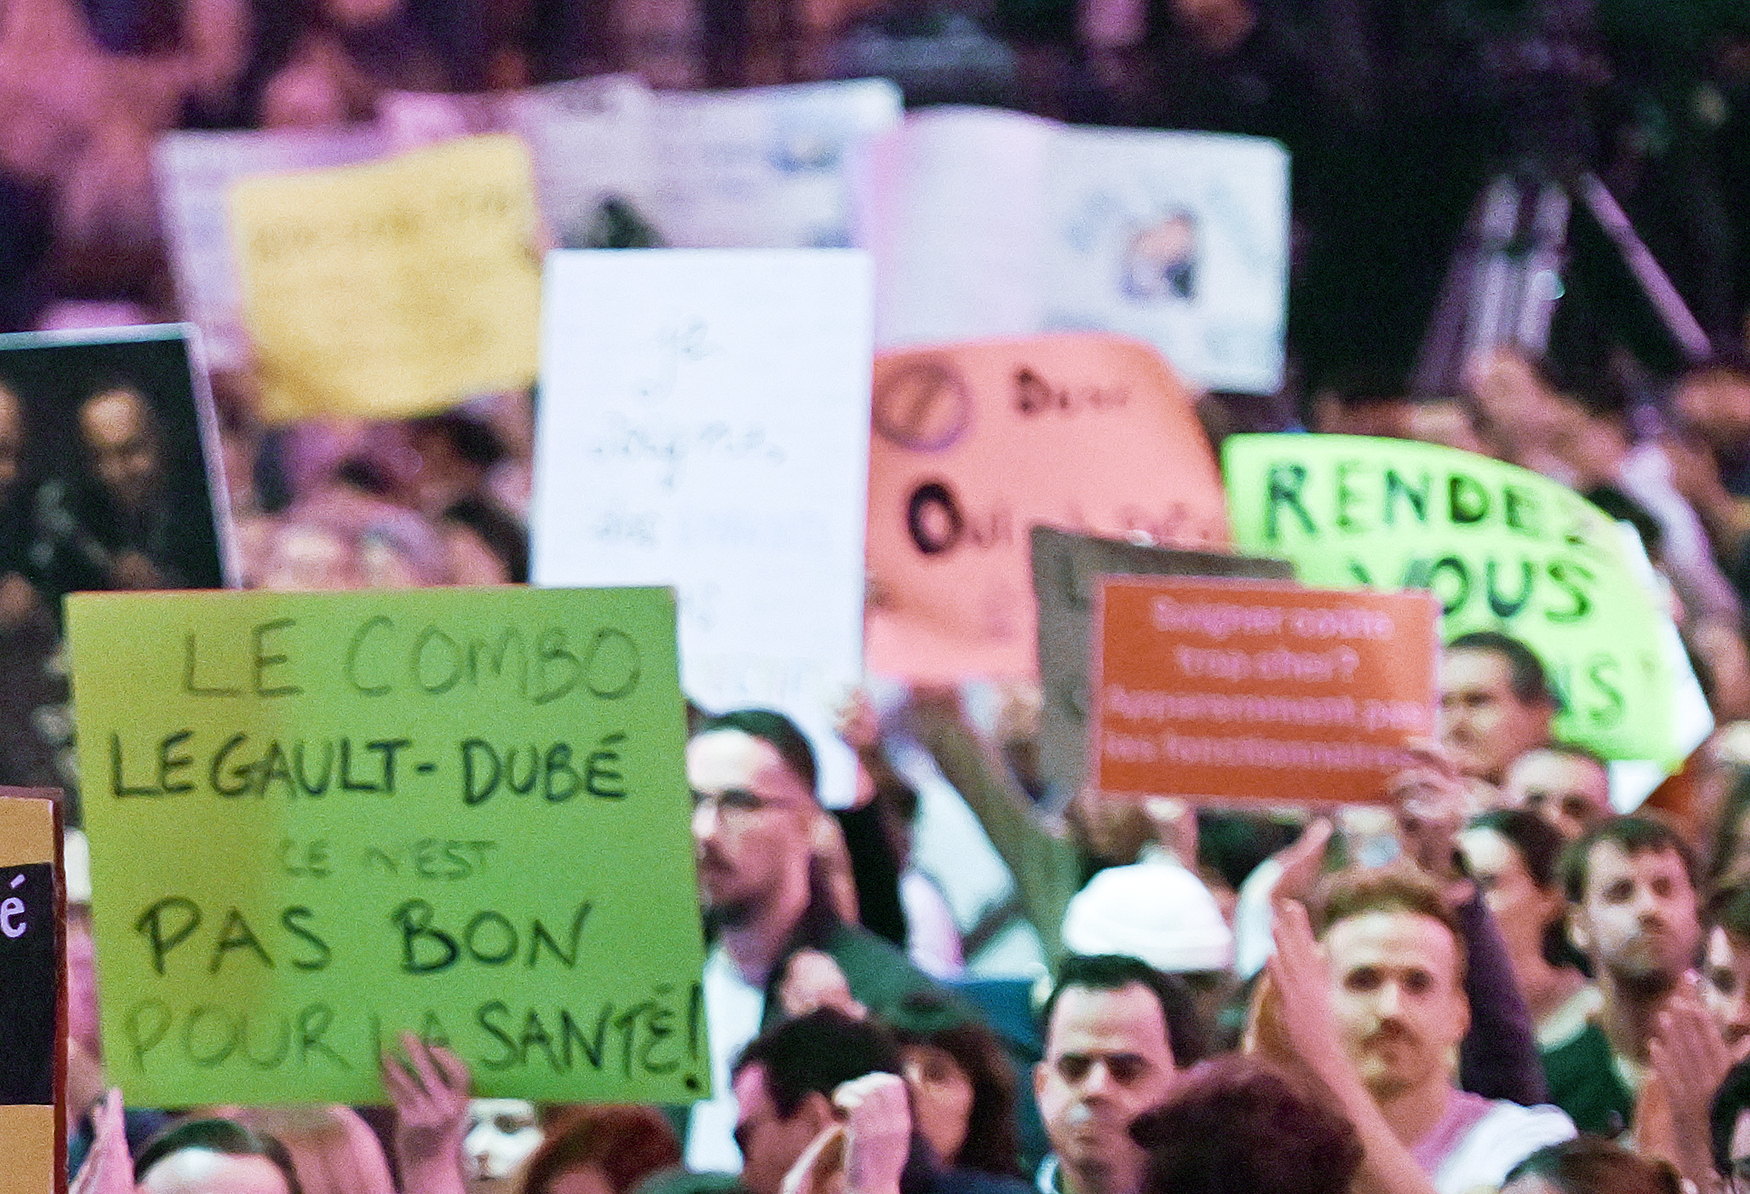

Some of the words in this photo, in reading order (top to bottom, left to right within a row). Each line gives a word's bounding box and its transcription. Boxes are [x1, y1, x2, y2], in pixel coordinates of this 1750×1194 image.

[184, 617, 305, 699] LE
[343, 614, 643, 705] COMBO
[109, 729, 628, 804] LEGAULT-DUBÉ
[133, 895, 333, 976] PAS
[392, 898, 593, 977] BON
[122, 1001, 348, 1076] POUR
[475, 981, 705, 1093] SANTÉ!
